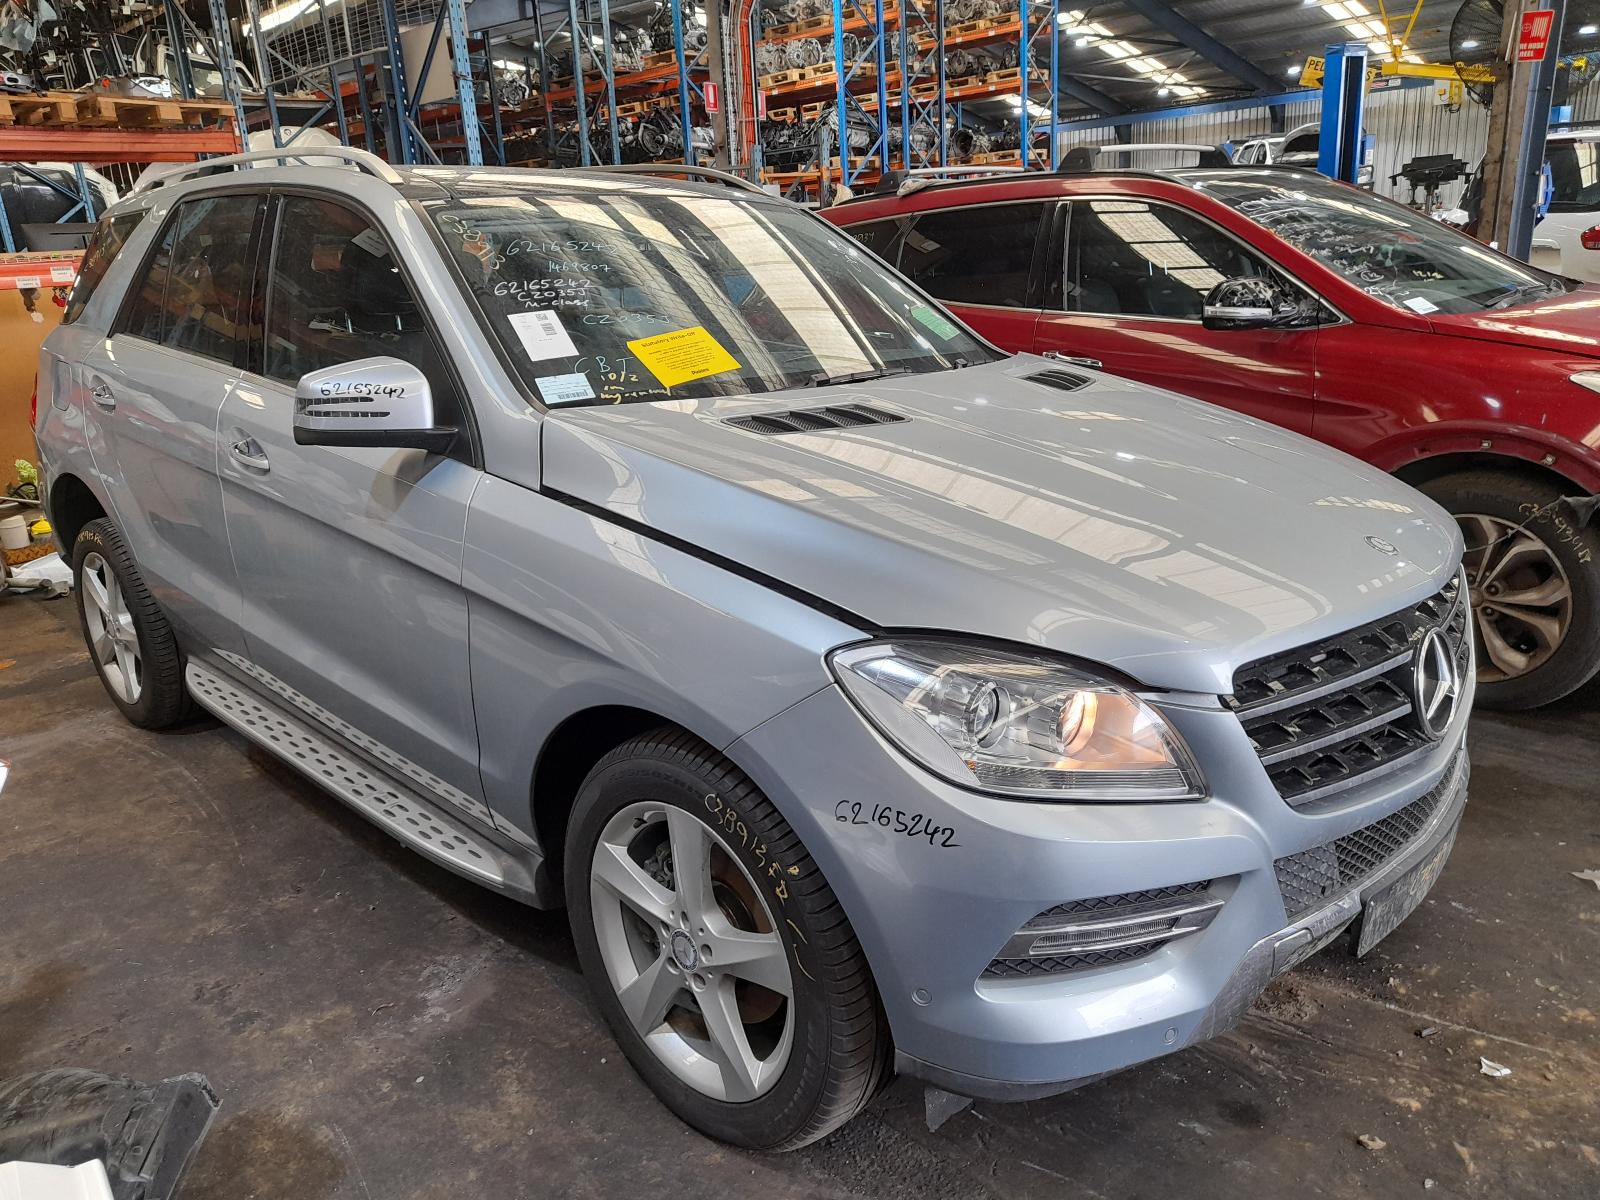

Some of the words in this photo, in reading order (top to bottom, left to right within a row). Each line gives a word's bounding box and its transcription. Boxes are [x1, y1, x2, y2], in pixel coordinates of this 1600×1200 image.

[494, 278, 595, 297] 62165242
[320, 382, 406, 399] 62165242
[834, 799, 963, 848] 62165242
